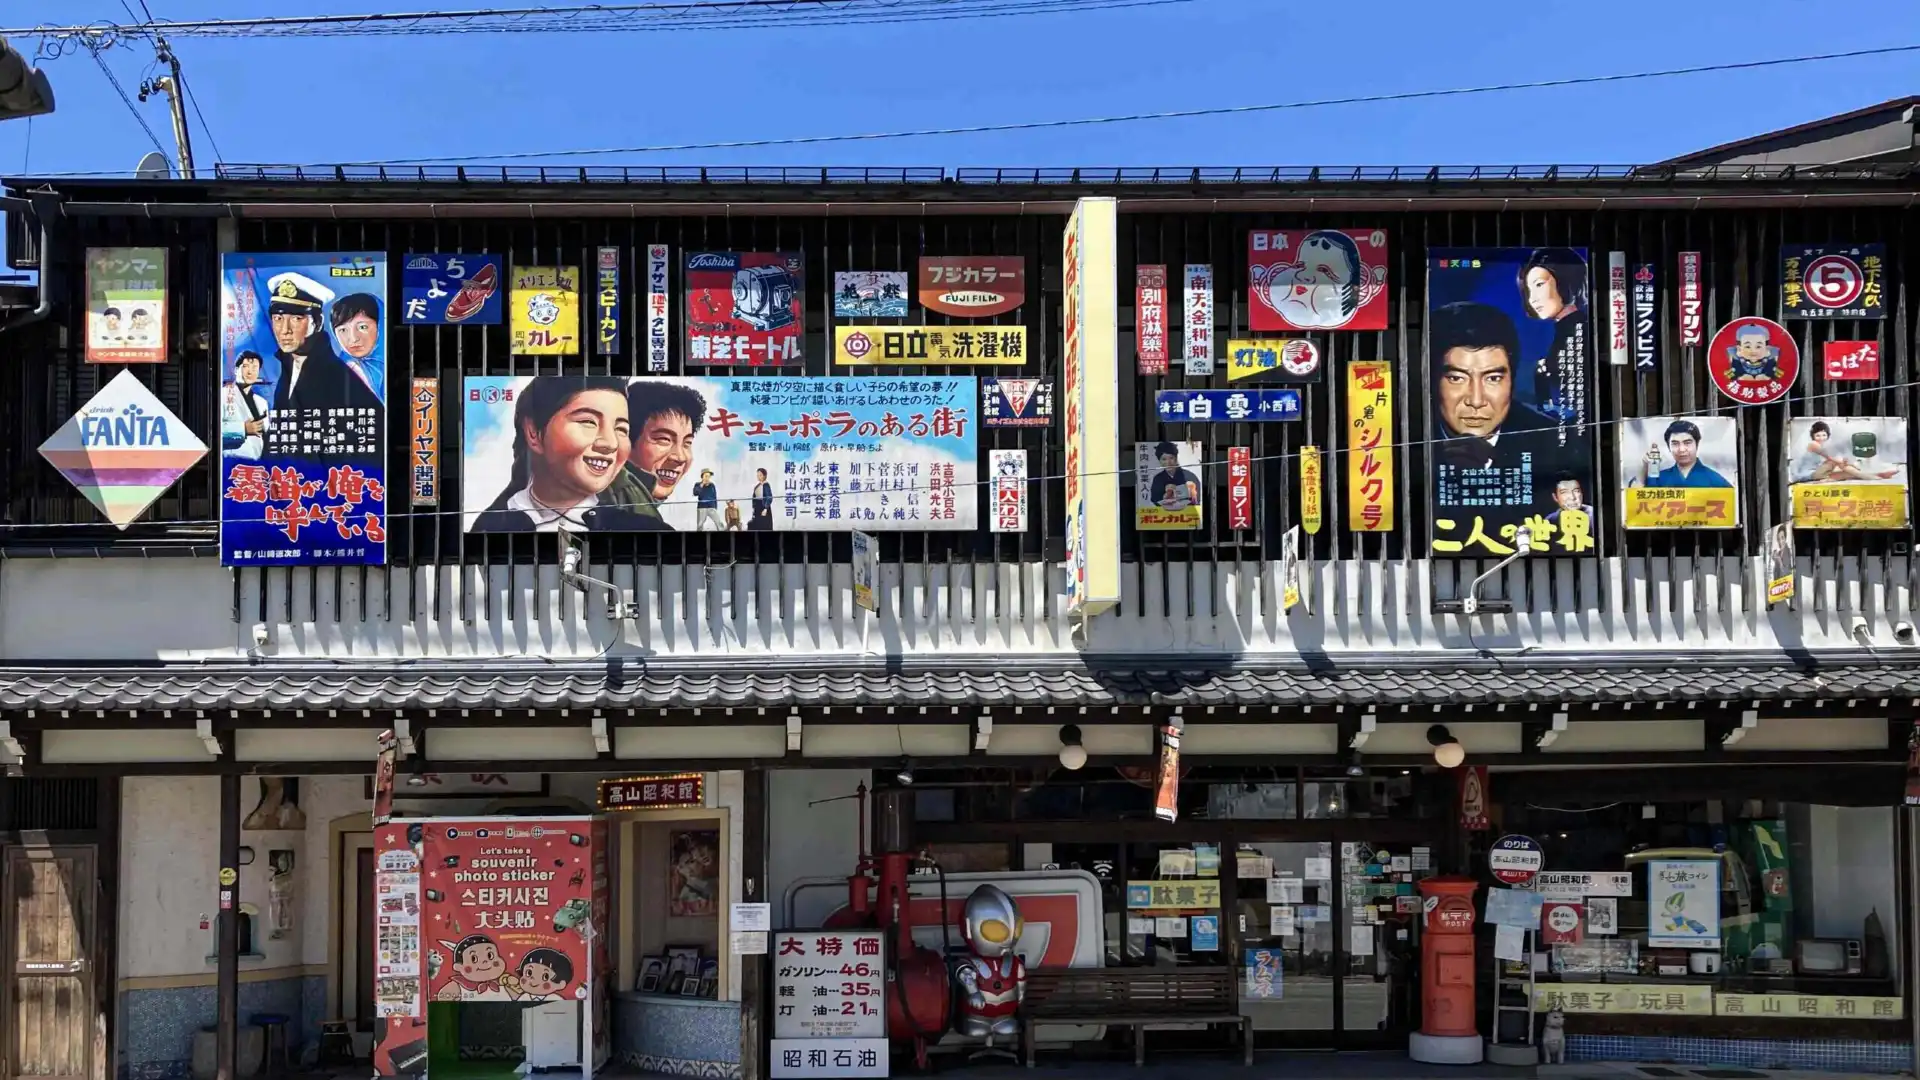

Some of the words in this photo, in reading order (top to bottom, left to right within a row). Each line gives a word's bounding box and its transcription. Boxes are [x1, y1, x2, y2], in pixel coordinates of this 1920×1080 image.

[1253, 233, 1289, 250] 日本
[1355, 231, 1386, 248] 一の
[96, 258, 158, 275] ヤンマー
[689, 254, 736, 269] Toshiba
[927, 266, 1016, 283] フジカラー
[406, 258, 466, 319] ちよだ
[1863, 256, 1882, 308] 地下たび
[945, 295, 971, 303] FUJI
[972, 295, 998, 303] FILM
[1612, 300, 1626, 350] キャラメル
[1636, 303, 1655, 367] ラクピス
[1682, 301, 1701, 344] マリン
[528, 330, 573, 347] カレー
[691, 336, 801, 360] 東芝モートル
[884, 330, 1022, 359] 日立電気洗濯機
[1234, 348, 1278, 367] 灯油
[1160, 401, 1184, 413] 清酒
[1188, 393, 1252, 419] 白雪
[1353, 392, 1388, 428] 片倉の
[81, 415, 170, 446] FANTA
[706, 406, 969, 438] キューポラのある街
[1139, 444, 1149, 461] 牛肉
[224, 464, 385, 504] 霧笛が俺を
[784, 462, 798, 520] 殿山泰司
[799, 462, 811, 516] 小沢昭一
[813, 462, 827, 520] 北林谷栄
[828, 463, 841, 519] 東野英治郎
[849, 462, 862, 520] 加藤武
[863, 462, 876, 520] 下元勉
[878, 462, 890, 520] 菅井きん
[893, 462, 905, 520] 浜村純
[907, 462, 920, 520] 河上信夫
[929, 462, 941, 519] 浜田光夫
[943, 462, 956, 519] 吉永小百合
[1359, 428, 1384, 530] シルク号
[1521, 452, 1533, 505] 石原裕次郎
[1232, 464, 1248, 528] 蛇ノ目ソース
[1636, 490, 1685, 500] 強力殺虫剤
[265, 500, 386, 543] 呼んでいる
[1635, 500, 1727, 520] ハイアース
[1432, 510, 1595, 554] 二人の世界
[609, 781, 694, 803] 高山昭和館
[480, 847, 502, 855] Let's
[504, 847, 524, 855] take
[1503, 840, 1530, 849] のりば
[471, 856, 538, 868] souvenir
[1493, 856, 1539, 865] 高山昭和館
[454, 870, 498, 883] photo
[502, 869, 556, 881] sticker
[1539, 874, 1592, 884] 高山昭和館
[461, 887, 549, 906] 스티커사진
[1152, 885, 1219, 904] 駄菓子
[474, 910, 535, 929] 大头贴
[779, 937, 880, 956] 大特価
[1255, 951, 1274, 998] ラムネ
[1546, 991, 1614, 1010] 駄菓子
[1640, 993, 1687, 1010] 玩具
[1724, 997, 1895, 1016] 高山昭和館
[783, 1049, 877, 1068] 昭和石油
